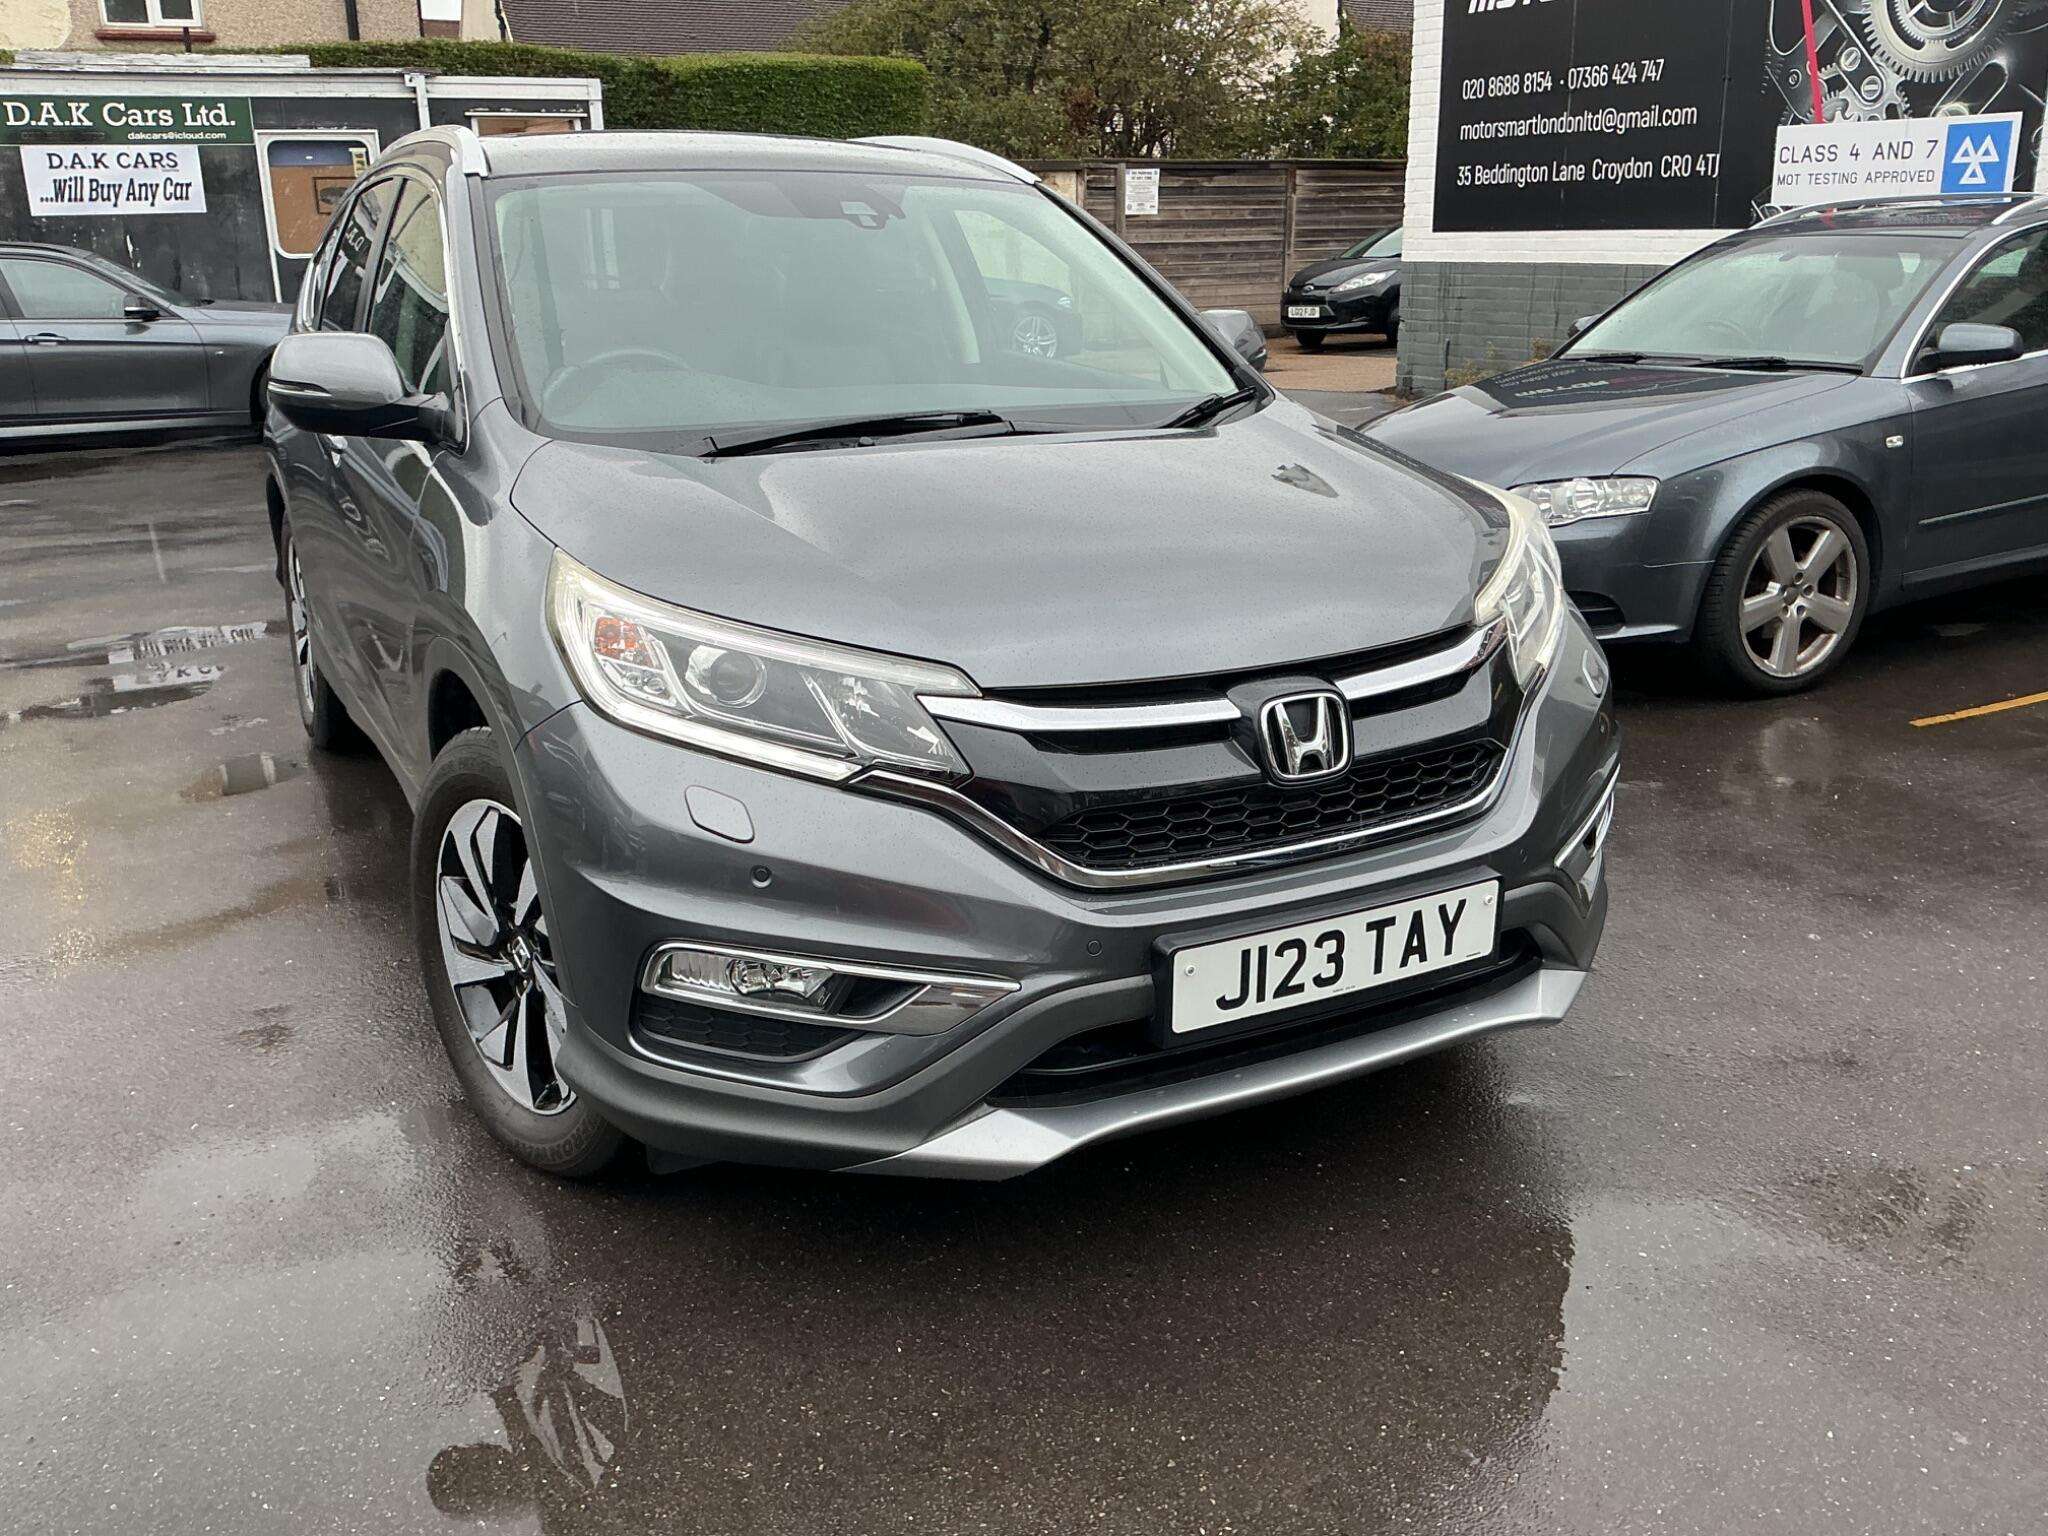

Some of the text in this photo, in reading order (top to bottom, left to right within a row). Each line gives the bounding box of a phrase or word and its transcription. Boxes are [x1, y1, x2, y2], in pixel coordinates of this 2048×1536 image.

[1462, 58, 1665, 100] 020 8688 8154 07366 424 747
[3, 102, 236, 127] D.A.K Cars Ltd.
[1460, 104, 1698, 141] motorsmartlondonltd@gmail.com
[127, 131, 227, 140] dakcars@icloud.com
[46, 152, 179, 169] D.A.K CARS
[1779, 140, 1938, 163] CLASS 4 AND 7
[1457, 166, 1471, 186] 35
[1474, 161, 1548, 188] Beddington
[1552, 161, 1585, 182] Lane
[1592, 157, 1653, 184] Croydon
[1777, 169, 1935, 186] MOT TESTING APPROVED
[88, 178, 122, 207] Buy
[126, 178, 159, 207] Any
[163, 177, 192, 201] Car
[1215, 898, 1467, 1011] J123 TAY
